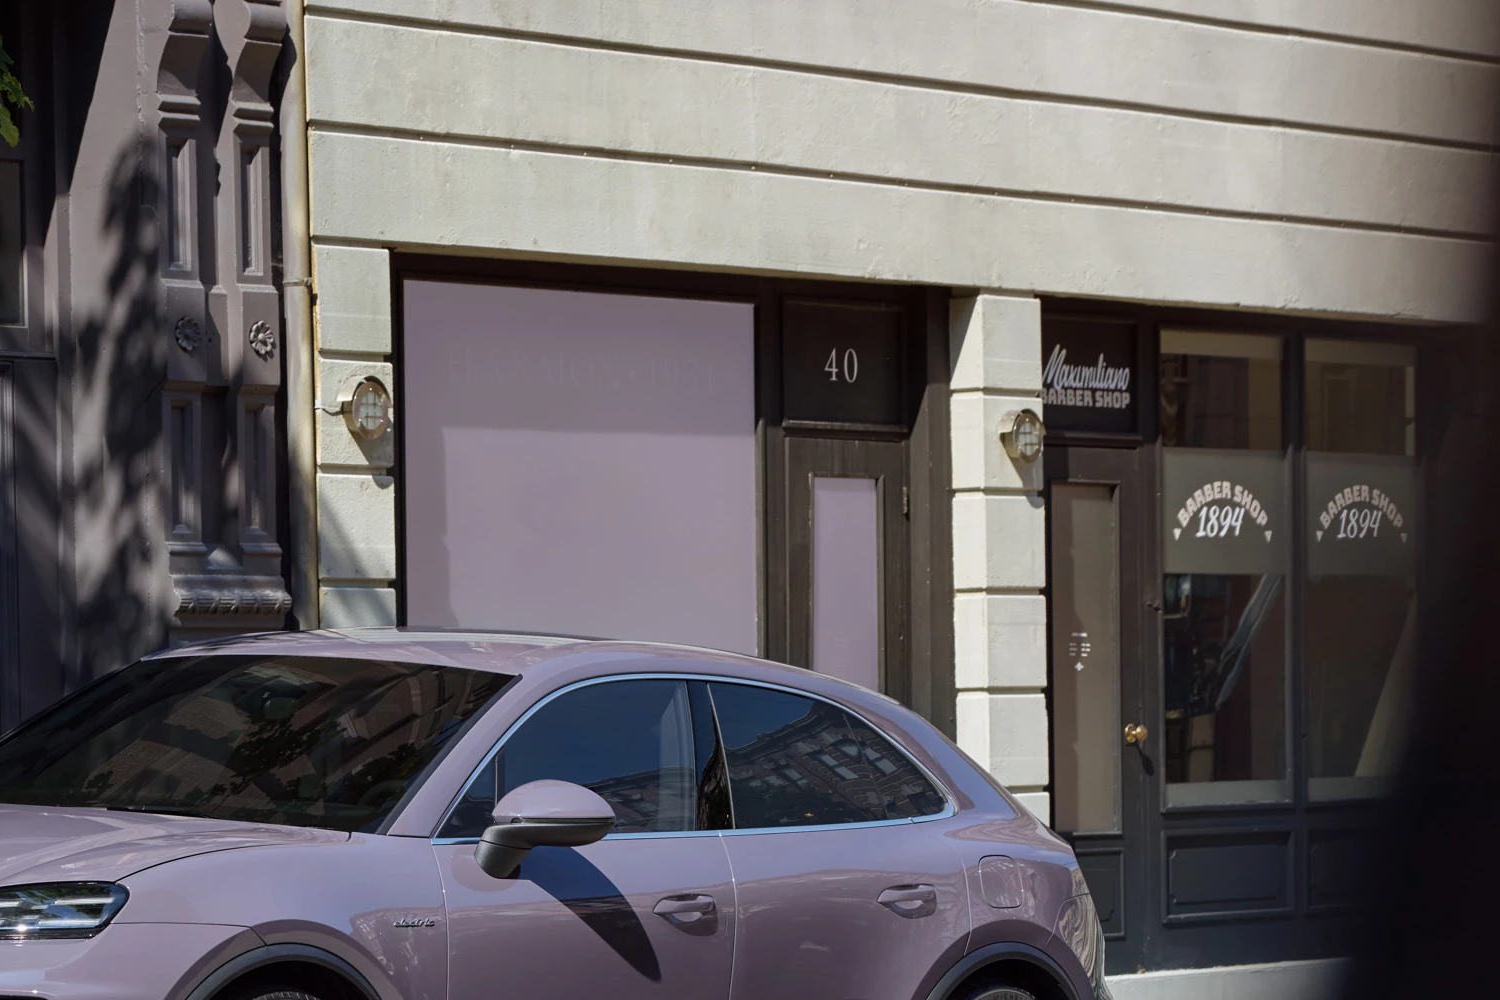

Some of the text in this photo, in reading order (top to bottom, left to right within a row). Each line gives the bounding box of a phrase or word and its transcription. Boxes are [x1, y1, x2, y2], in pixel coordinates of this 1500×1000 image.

[824, 347, 858, 383] 40
[1041, 343, 1130, 391] Maximiliano
[1094, 390, 1131, 409] SHOP
[1176, 480, 1269, 528] BARBER SHOP
[1195, 504, 1245, 538] 1894
[1319, 484, 1405, 529] BARBER SHOP
[1336, 508, 1382, 539] 1894
[393, 917, 436, 928] electric
